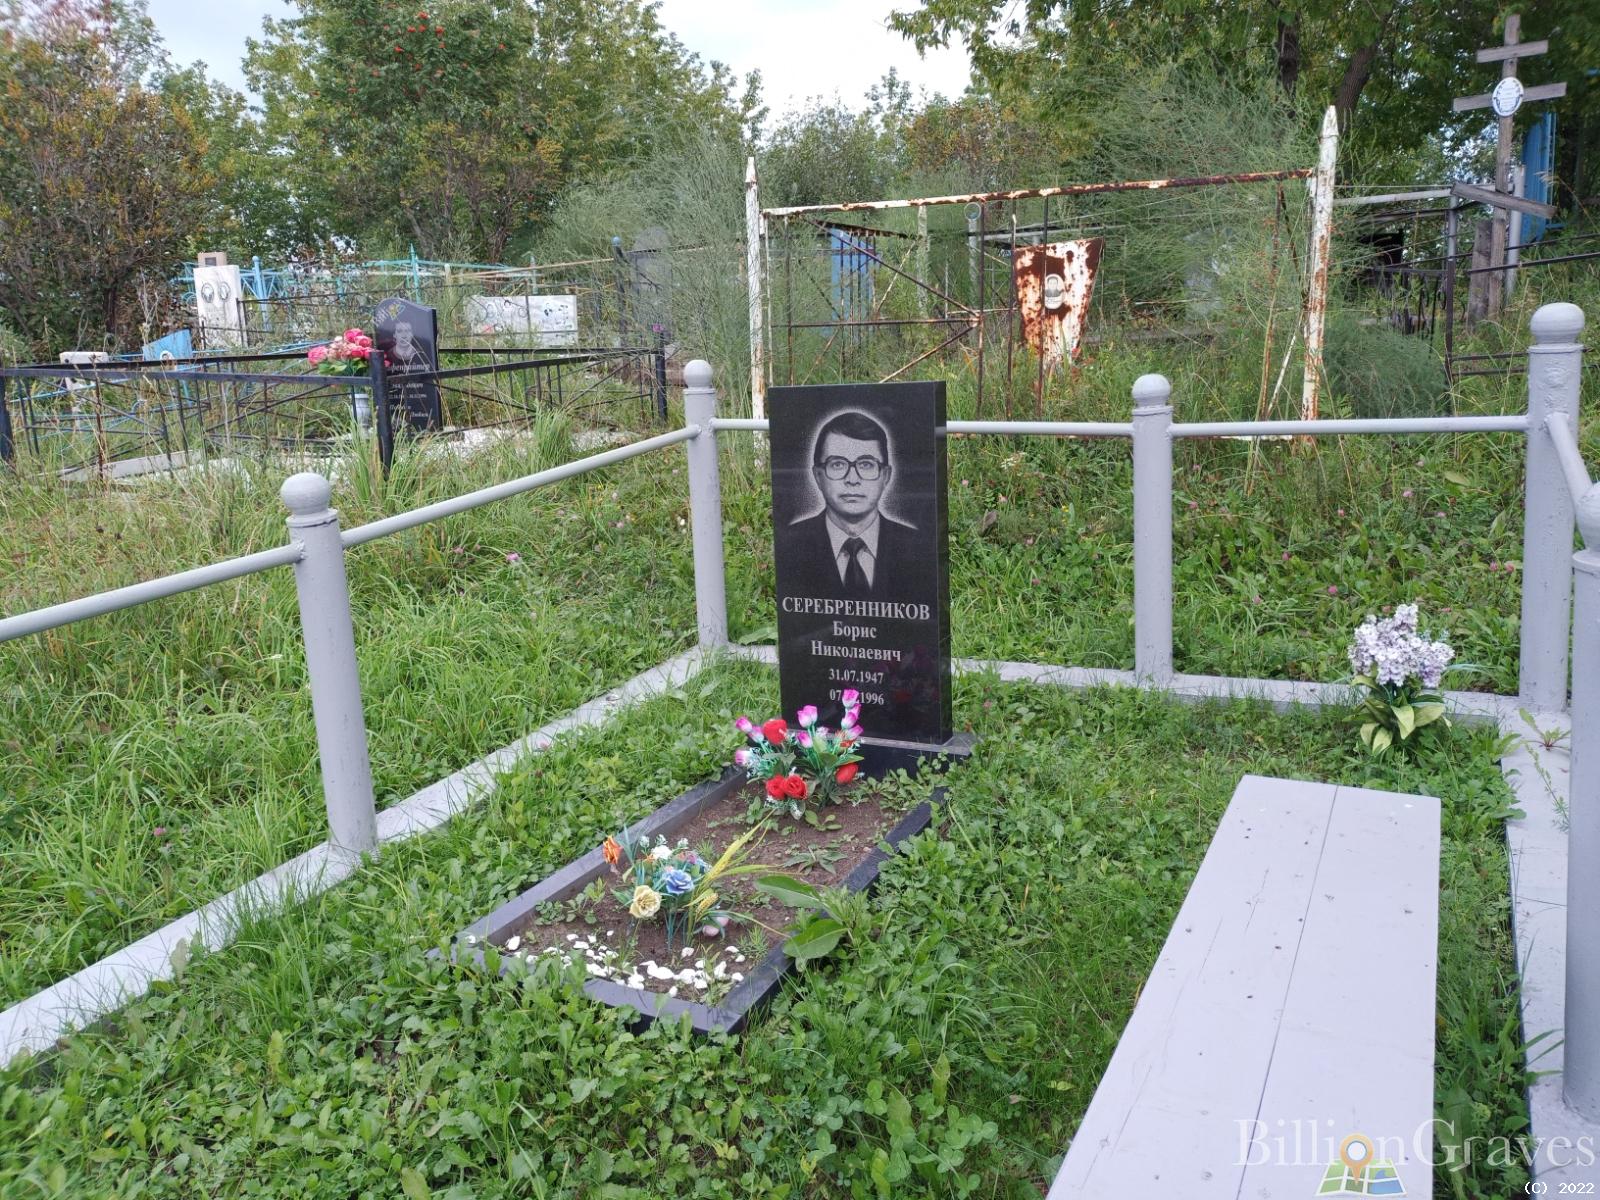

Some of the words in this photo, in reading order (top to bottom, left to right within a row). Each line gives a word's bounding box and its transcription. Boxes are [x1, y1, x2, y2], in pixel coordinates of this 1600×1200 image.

[782, 596, 931, 620] СЕРЕБРЕННИКОВ
[833, 620, 878, 641] Борис
[811, 640, 902, 662] Николаевич
[828, 668, 885, 685] 31.07.1947
